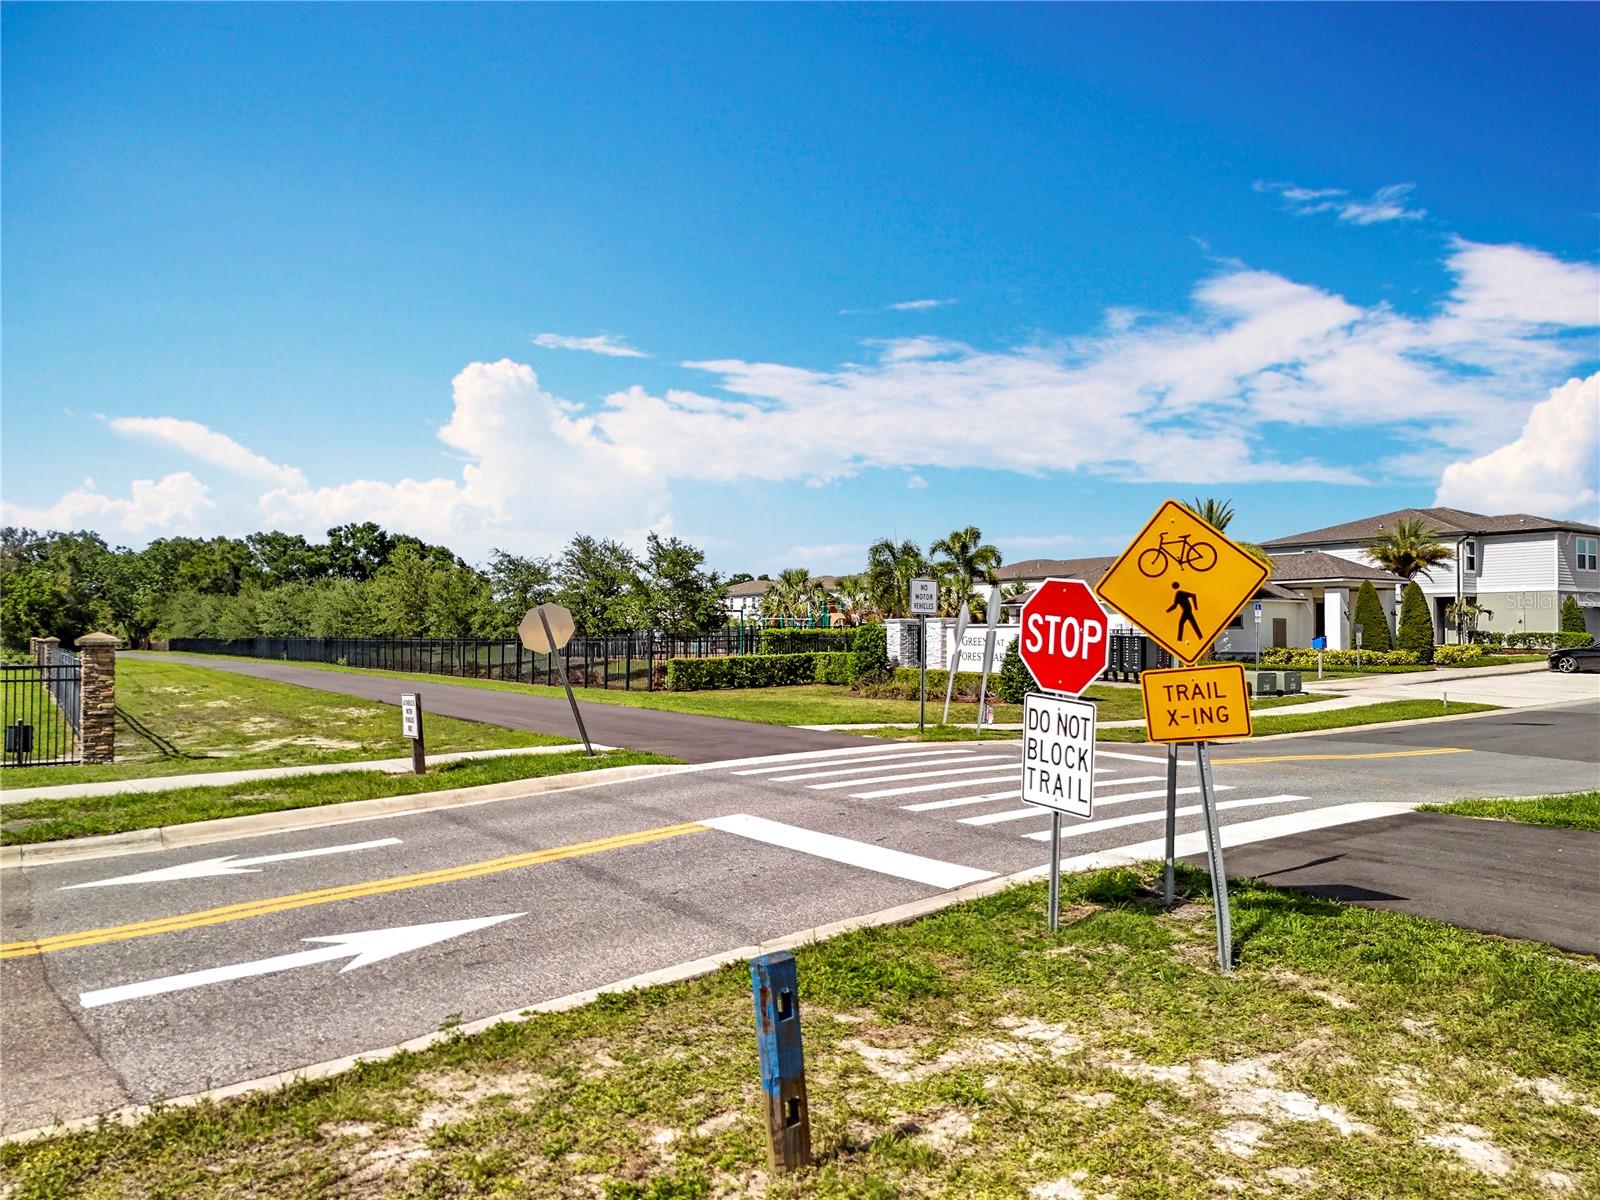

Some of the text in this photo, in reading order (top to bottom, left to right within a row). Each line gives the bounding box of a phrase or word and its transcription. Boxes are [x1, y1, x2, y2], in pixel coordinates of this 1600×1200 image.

[913, 602, 934, 610] VEHICLES
[996, 639, 1005, 647] AT
[1025, 612, 1103, 660] STOP
[1162, 681, 1227, 702] TRAIL
[1028, 708, 1090, 741] DO NOT
[1166, 705, 1229, 726] X-ING
[1027, 737, 1089, 773] BLOCK
[1027, 766, 1088, 804] TRAIL
